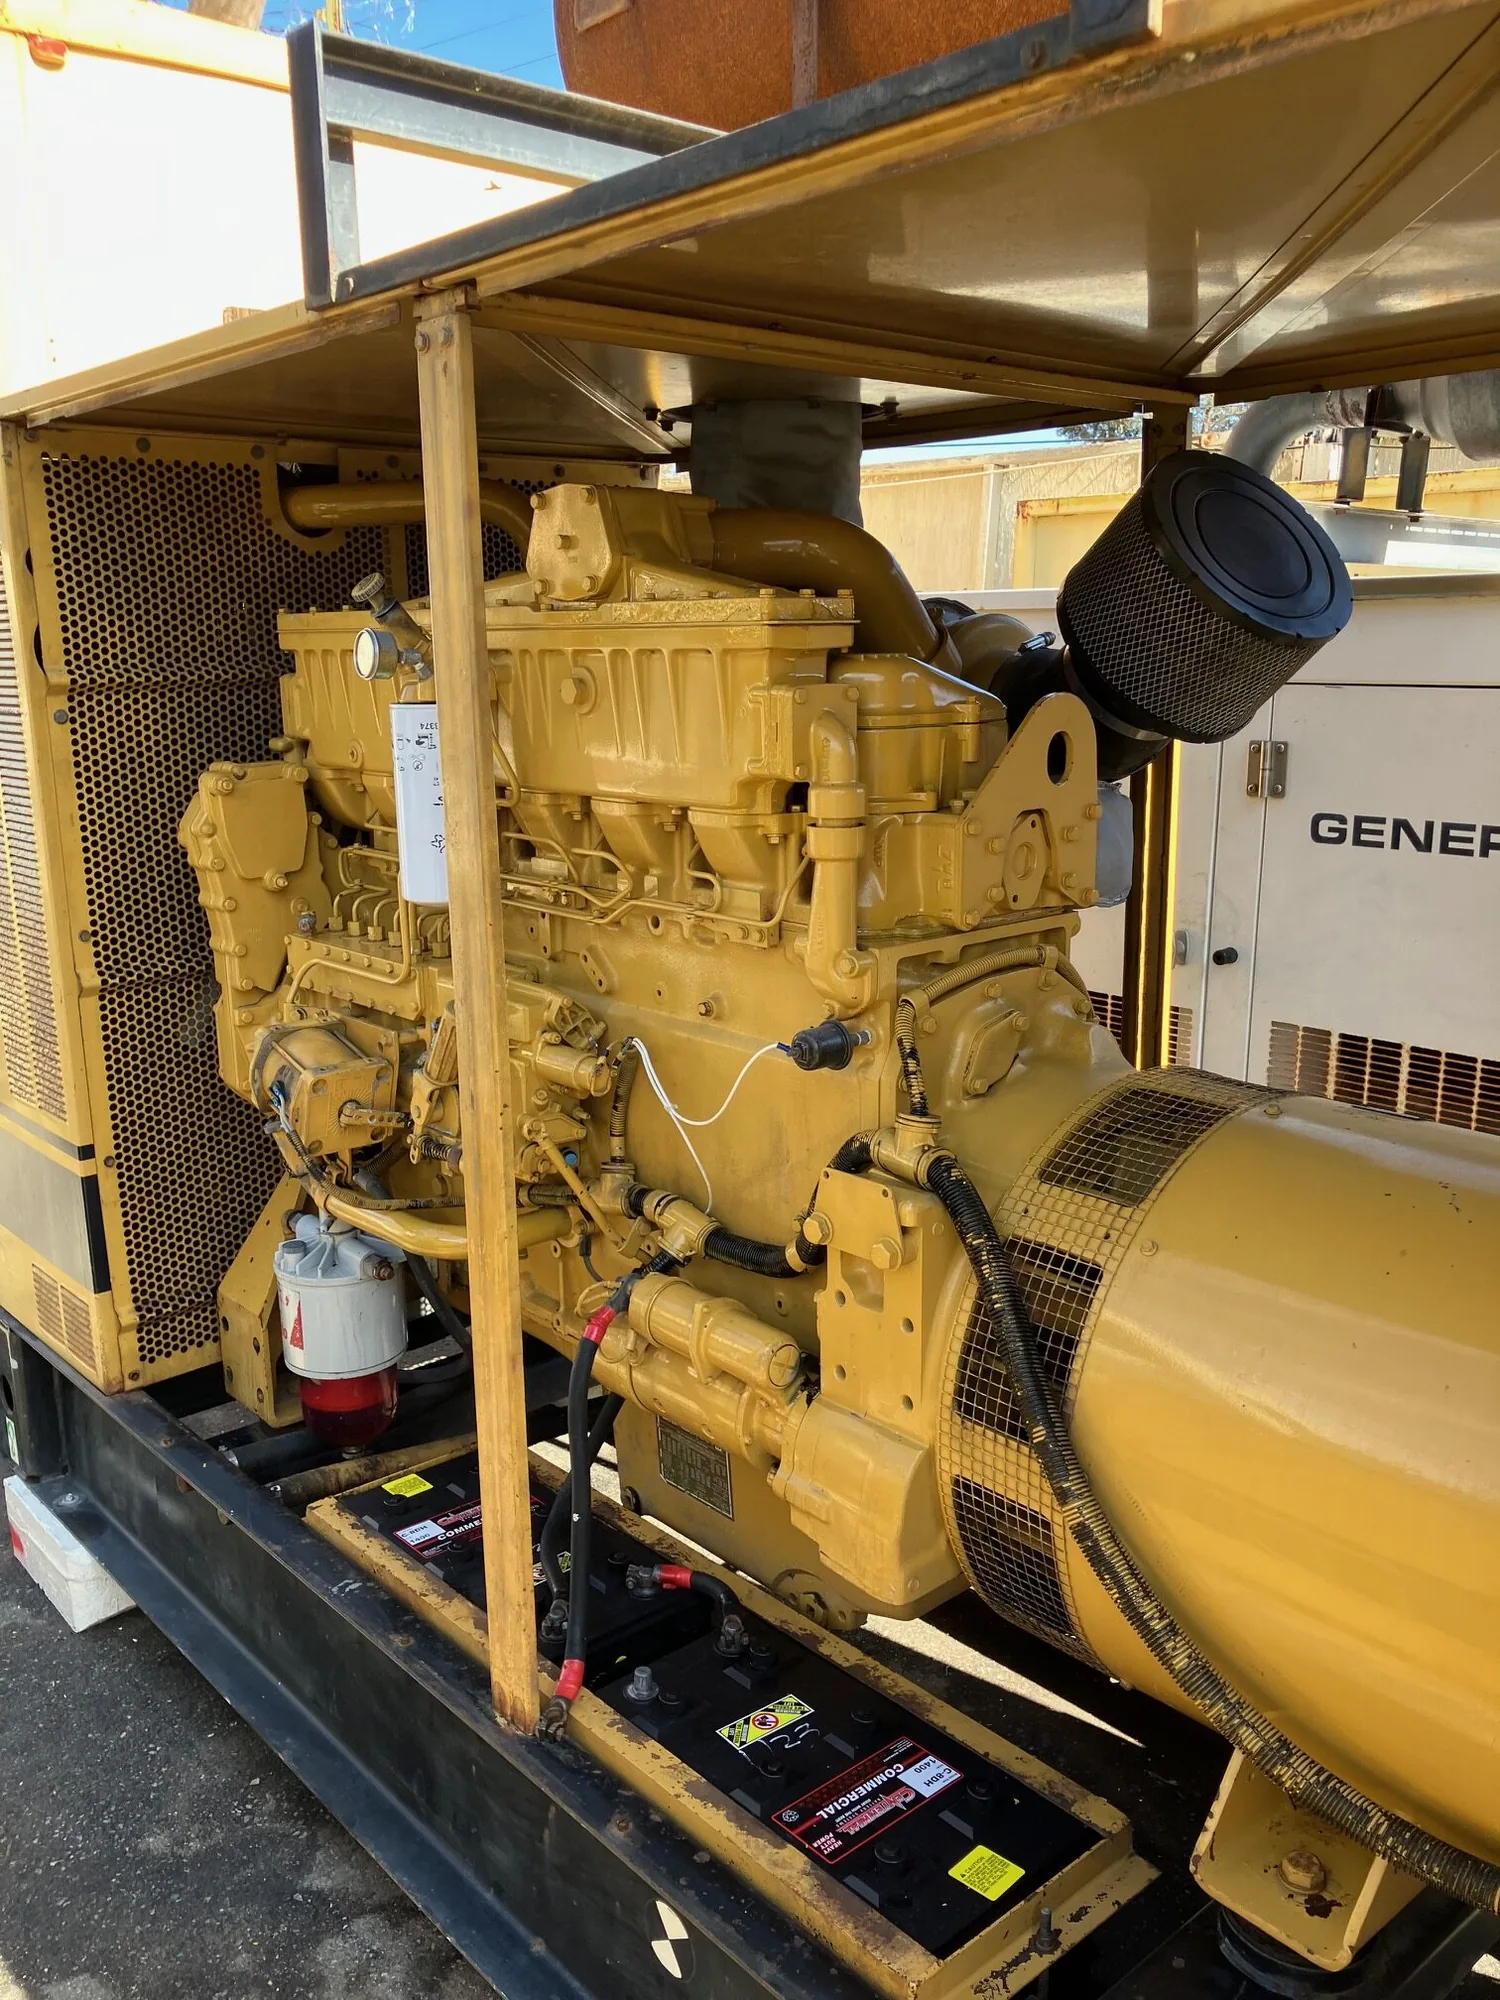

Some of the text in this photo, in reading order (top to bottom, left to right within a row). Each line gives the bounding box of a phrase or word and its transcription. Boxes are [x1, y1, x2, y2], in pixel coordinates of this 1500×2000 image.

[437, 1519, 482, 1541] COMME
[914, 1758, 937, 1773] 1400
[923, 1767, 952, 1787] C-8DH
[815, 1763, 905, 1819] COMMERCIAL
[811, 1831, 834, 1848] POWER
[819, 1837, 836, 1850] DUTY
[822, 1840, 843, 1855] HEAVY
[964, 1856, 986, 1874] CAUTION
